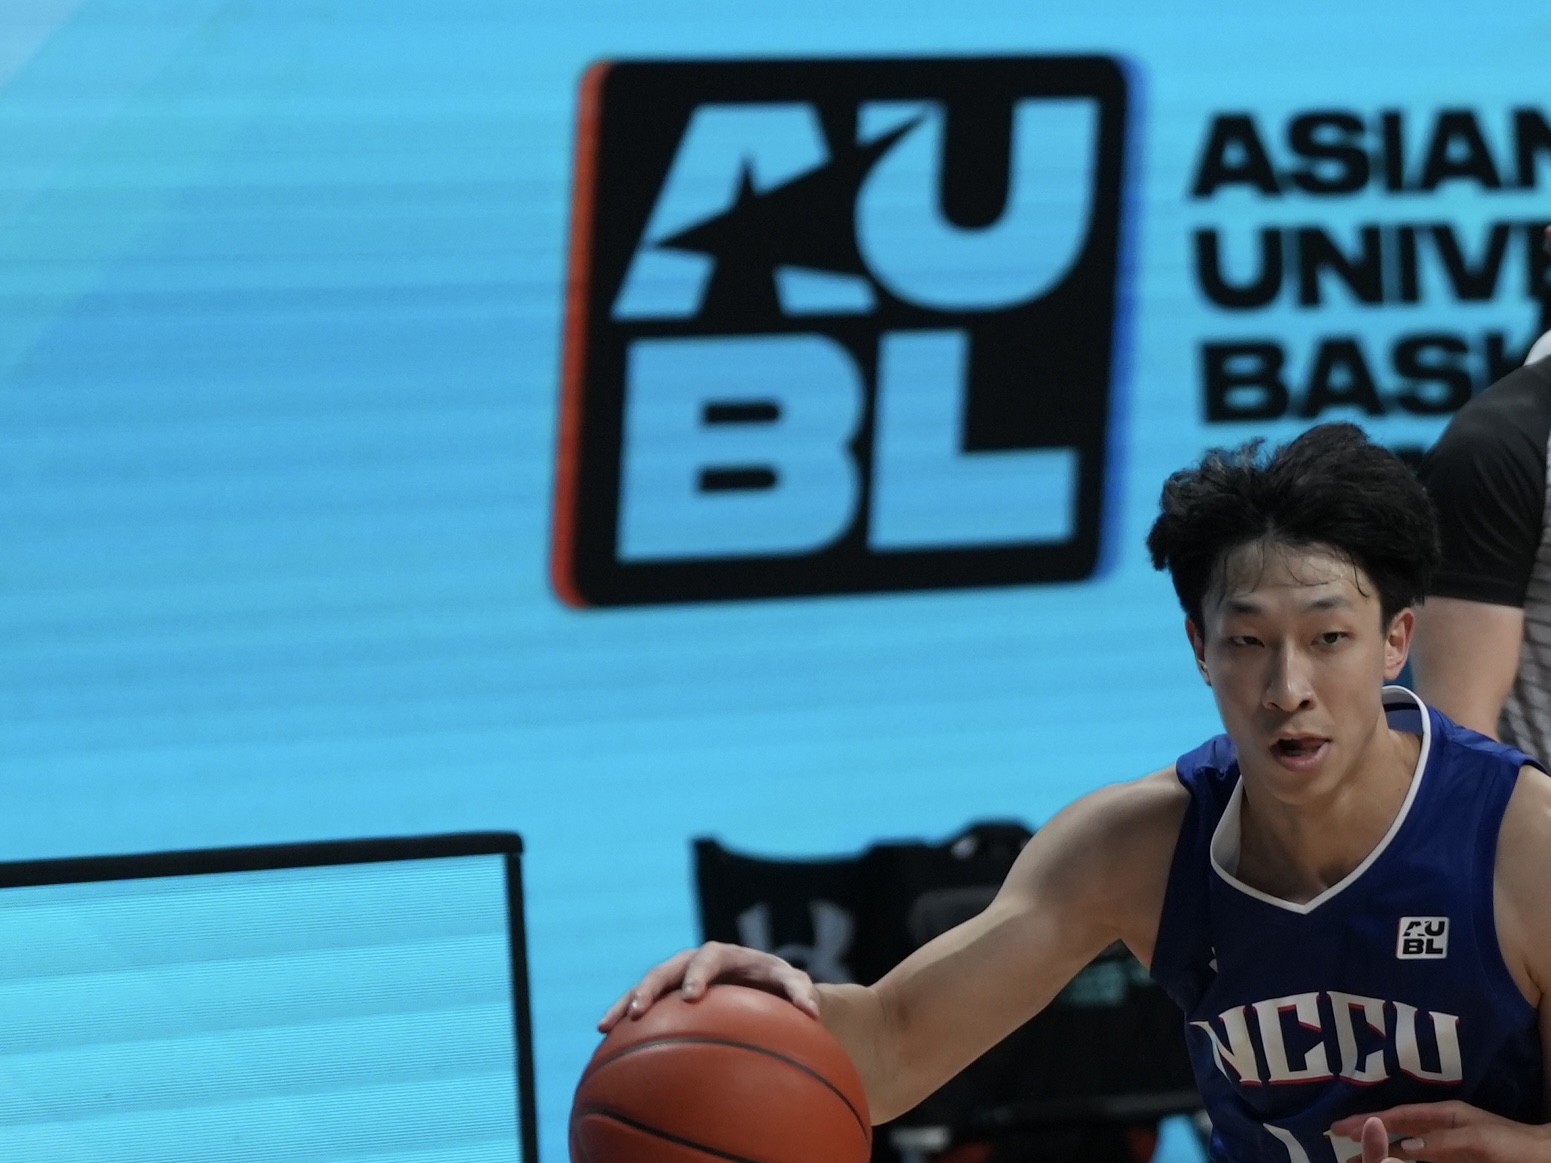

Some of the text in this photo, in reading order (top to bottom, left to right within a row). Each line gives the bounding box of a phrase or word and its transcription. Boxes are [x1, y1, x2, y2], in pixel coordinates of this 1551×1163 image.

[615, 329, 1079, 563] BL
[1402, 938, 1443, 955] BL
[1189, 990, 1463, 1087] NCCU
